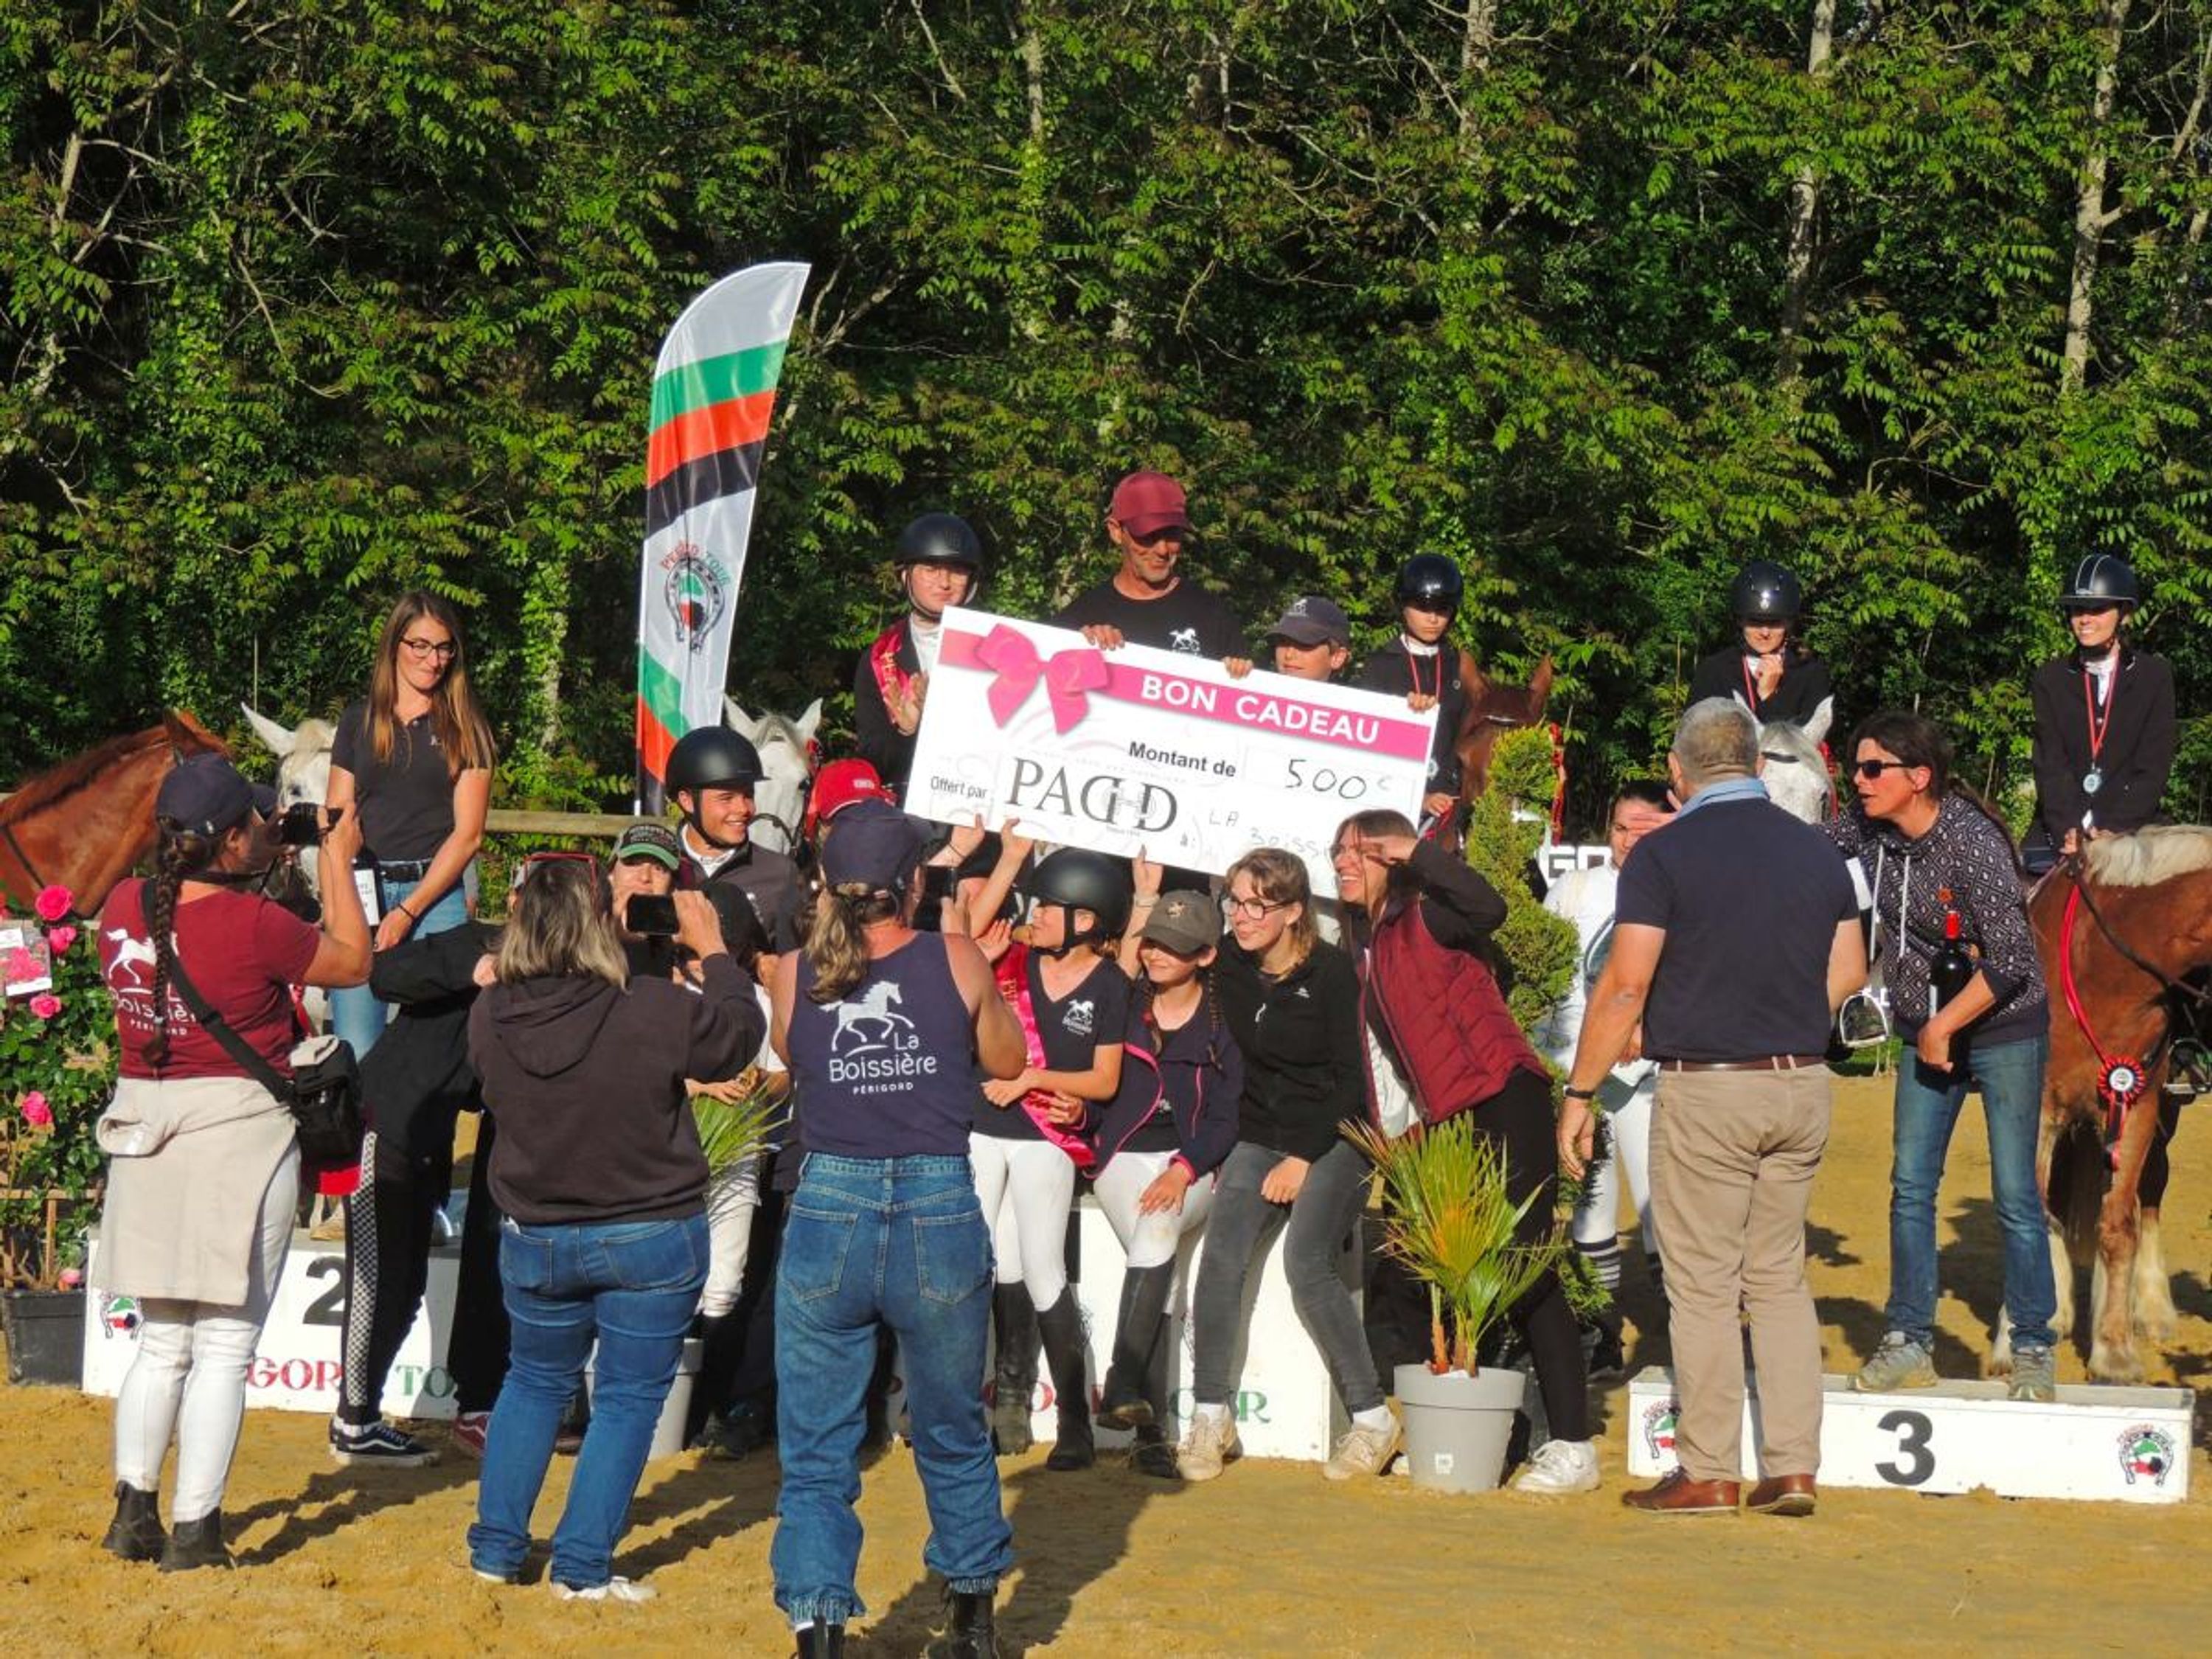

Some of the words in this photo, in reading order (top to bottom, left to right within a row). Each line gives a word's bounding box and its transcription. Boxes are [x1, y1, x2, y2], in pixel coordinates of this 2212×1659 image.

[1141, 675, 1217, 712] BON
[1236, 696, 1379, 744] CADEAU
[1129, 741, 1208, 771] Montant
[1213, 753, 1237, 777] de
[931, 775, 965, 795] Offert
[967, 785, 988, 800] par
[894, 1032, 919, 1051] La
[829, 1052, 937, 1082] Boissière
[852, 1081, 914, 1095] PÉRIGORD
[302, 1256, 346, 1326] 2
[394, 1364, 456, 1399] TO
[1874, 1409, 1935, 1486] 3
